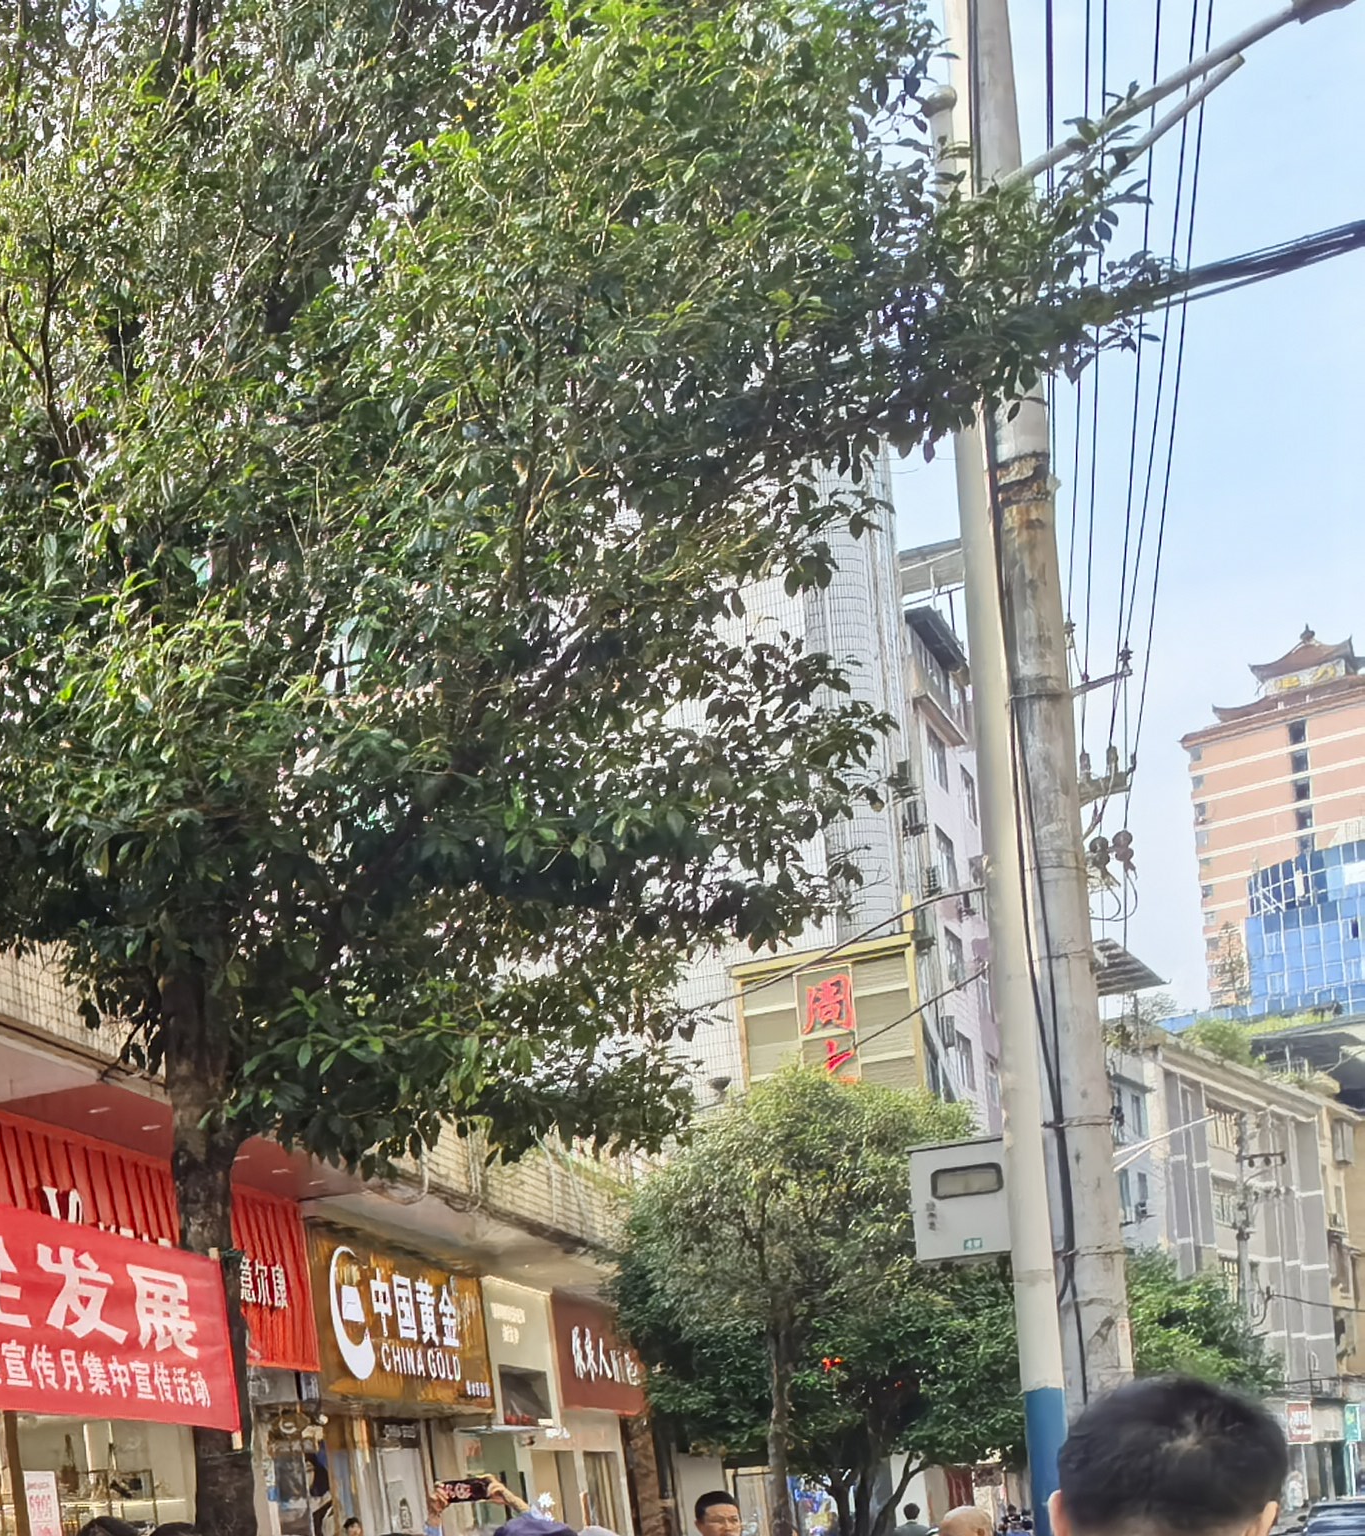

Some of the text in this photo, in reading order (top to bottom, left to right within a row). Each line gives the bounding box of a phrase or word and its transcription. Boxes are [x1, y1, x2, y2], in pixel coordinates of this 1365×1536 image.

[369, 1266, 461, 1348] 中国黄金
[380, 1342, 462, 1382] CHINA GOLD
